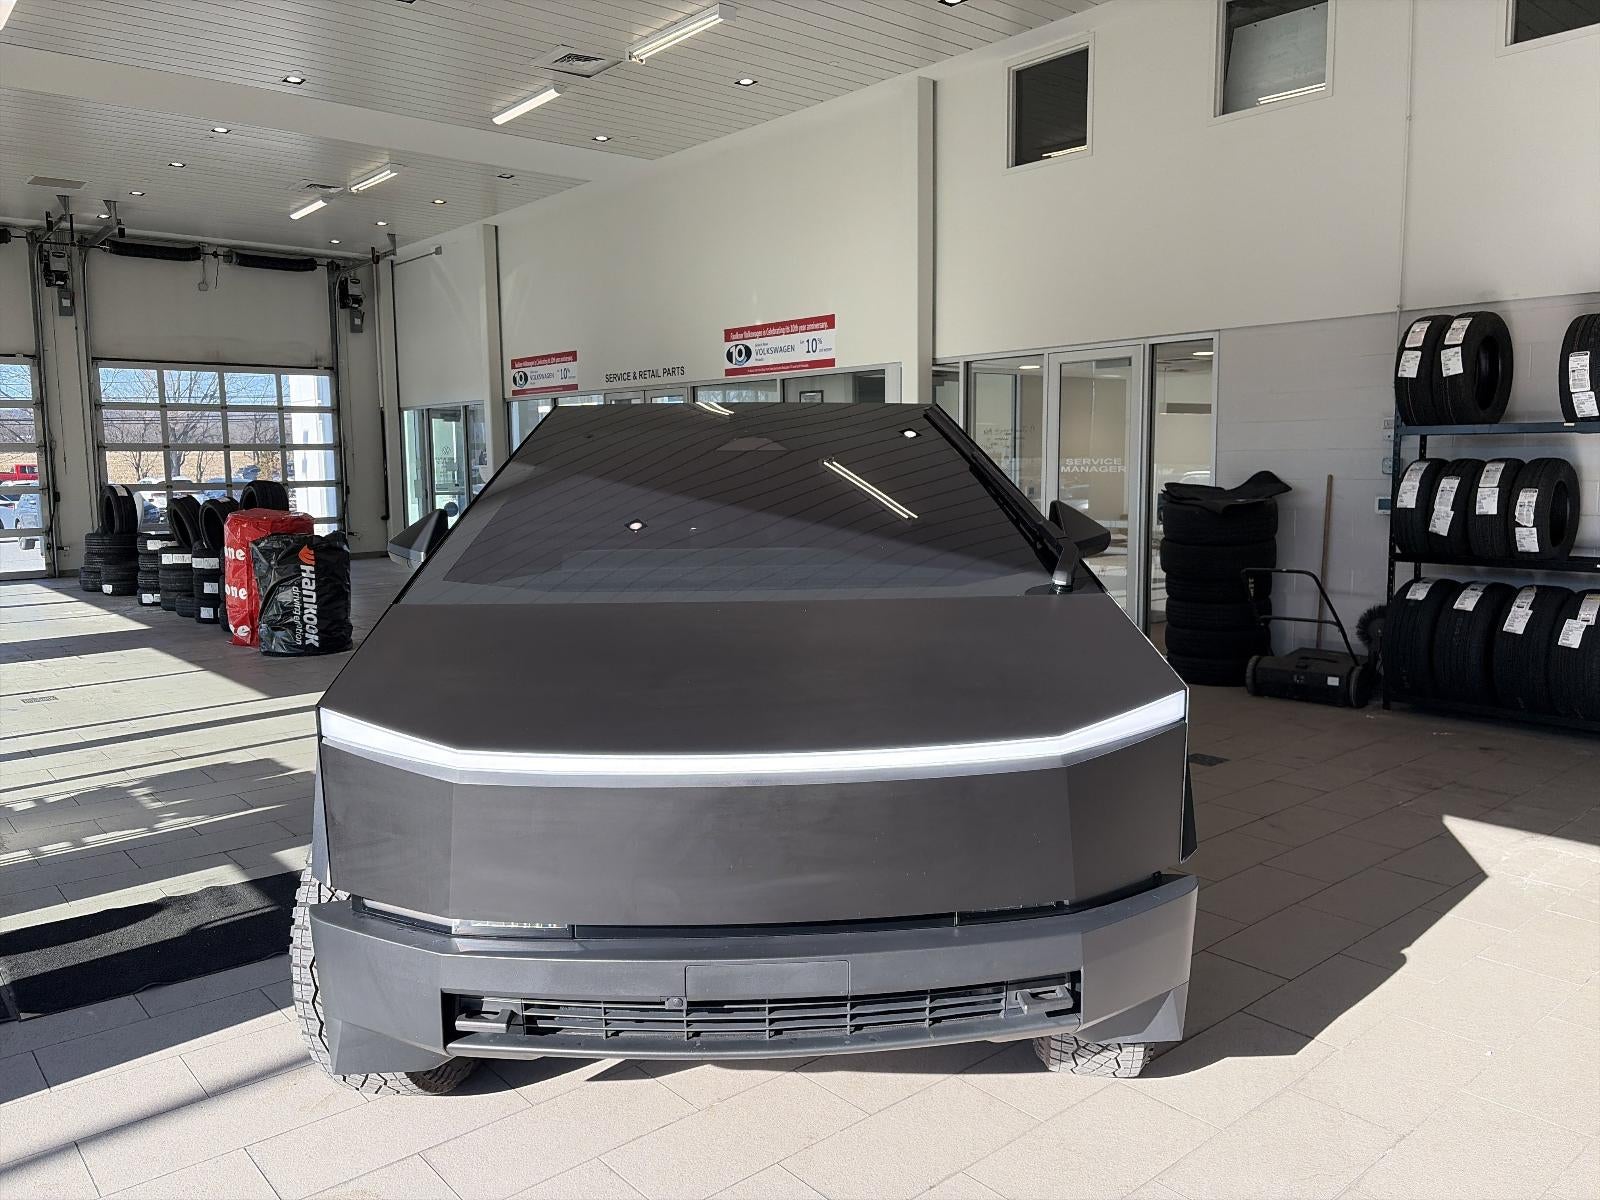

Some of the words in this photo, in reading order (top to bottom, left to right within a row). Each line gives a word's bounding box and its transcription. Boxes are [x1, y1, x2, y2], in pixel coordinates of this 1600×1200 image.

[729, 345, 746, 365] 10
[755, 344, 796, 356] VOLKSWAGEN
[605, 371, 631, 383] SERVICE
[632, 370, 638, 381] &
[638, 368, 661, 380] RETAIL
[662, 365, 685, 377] PARTS
[1065, 457, 1122, 466] SERVICE
[1060, 465, 1128, 473] MANAGER
